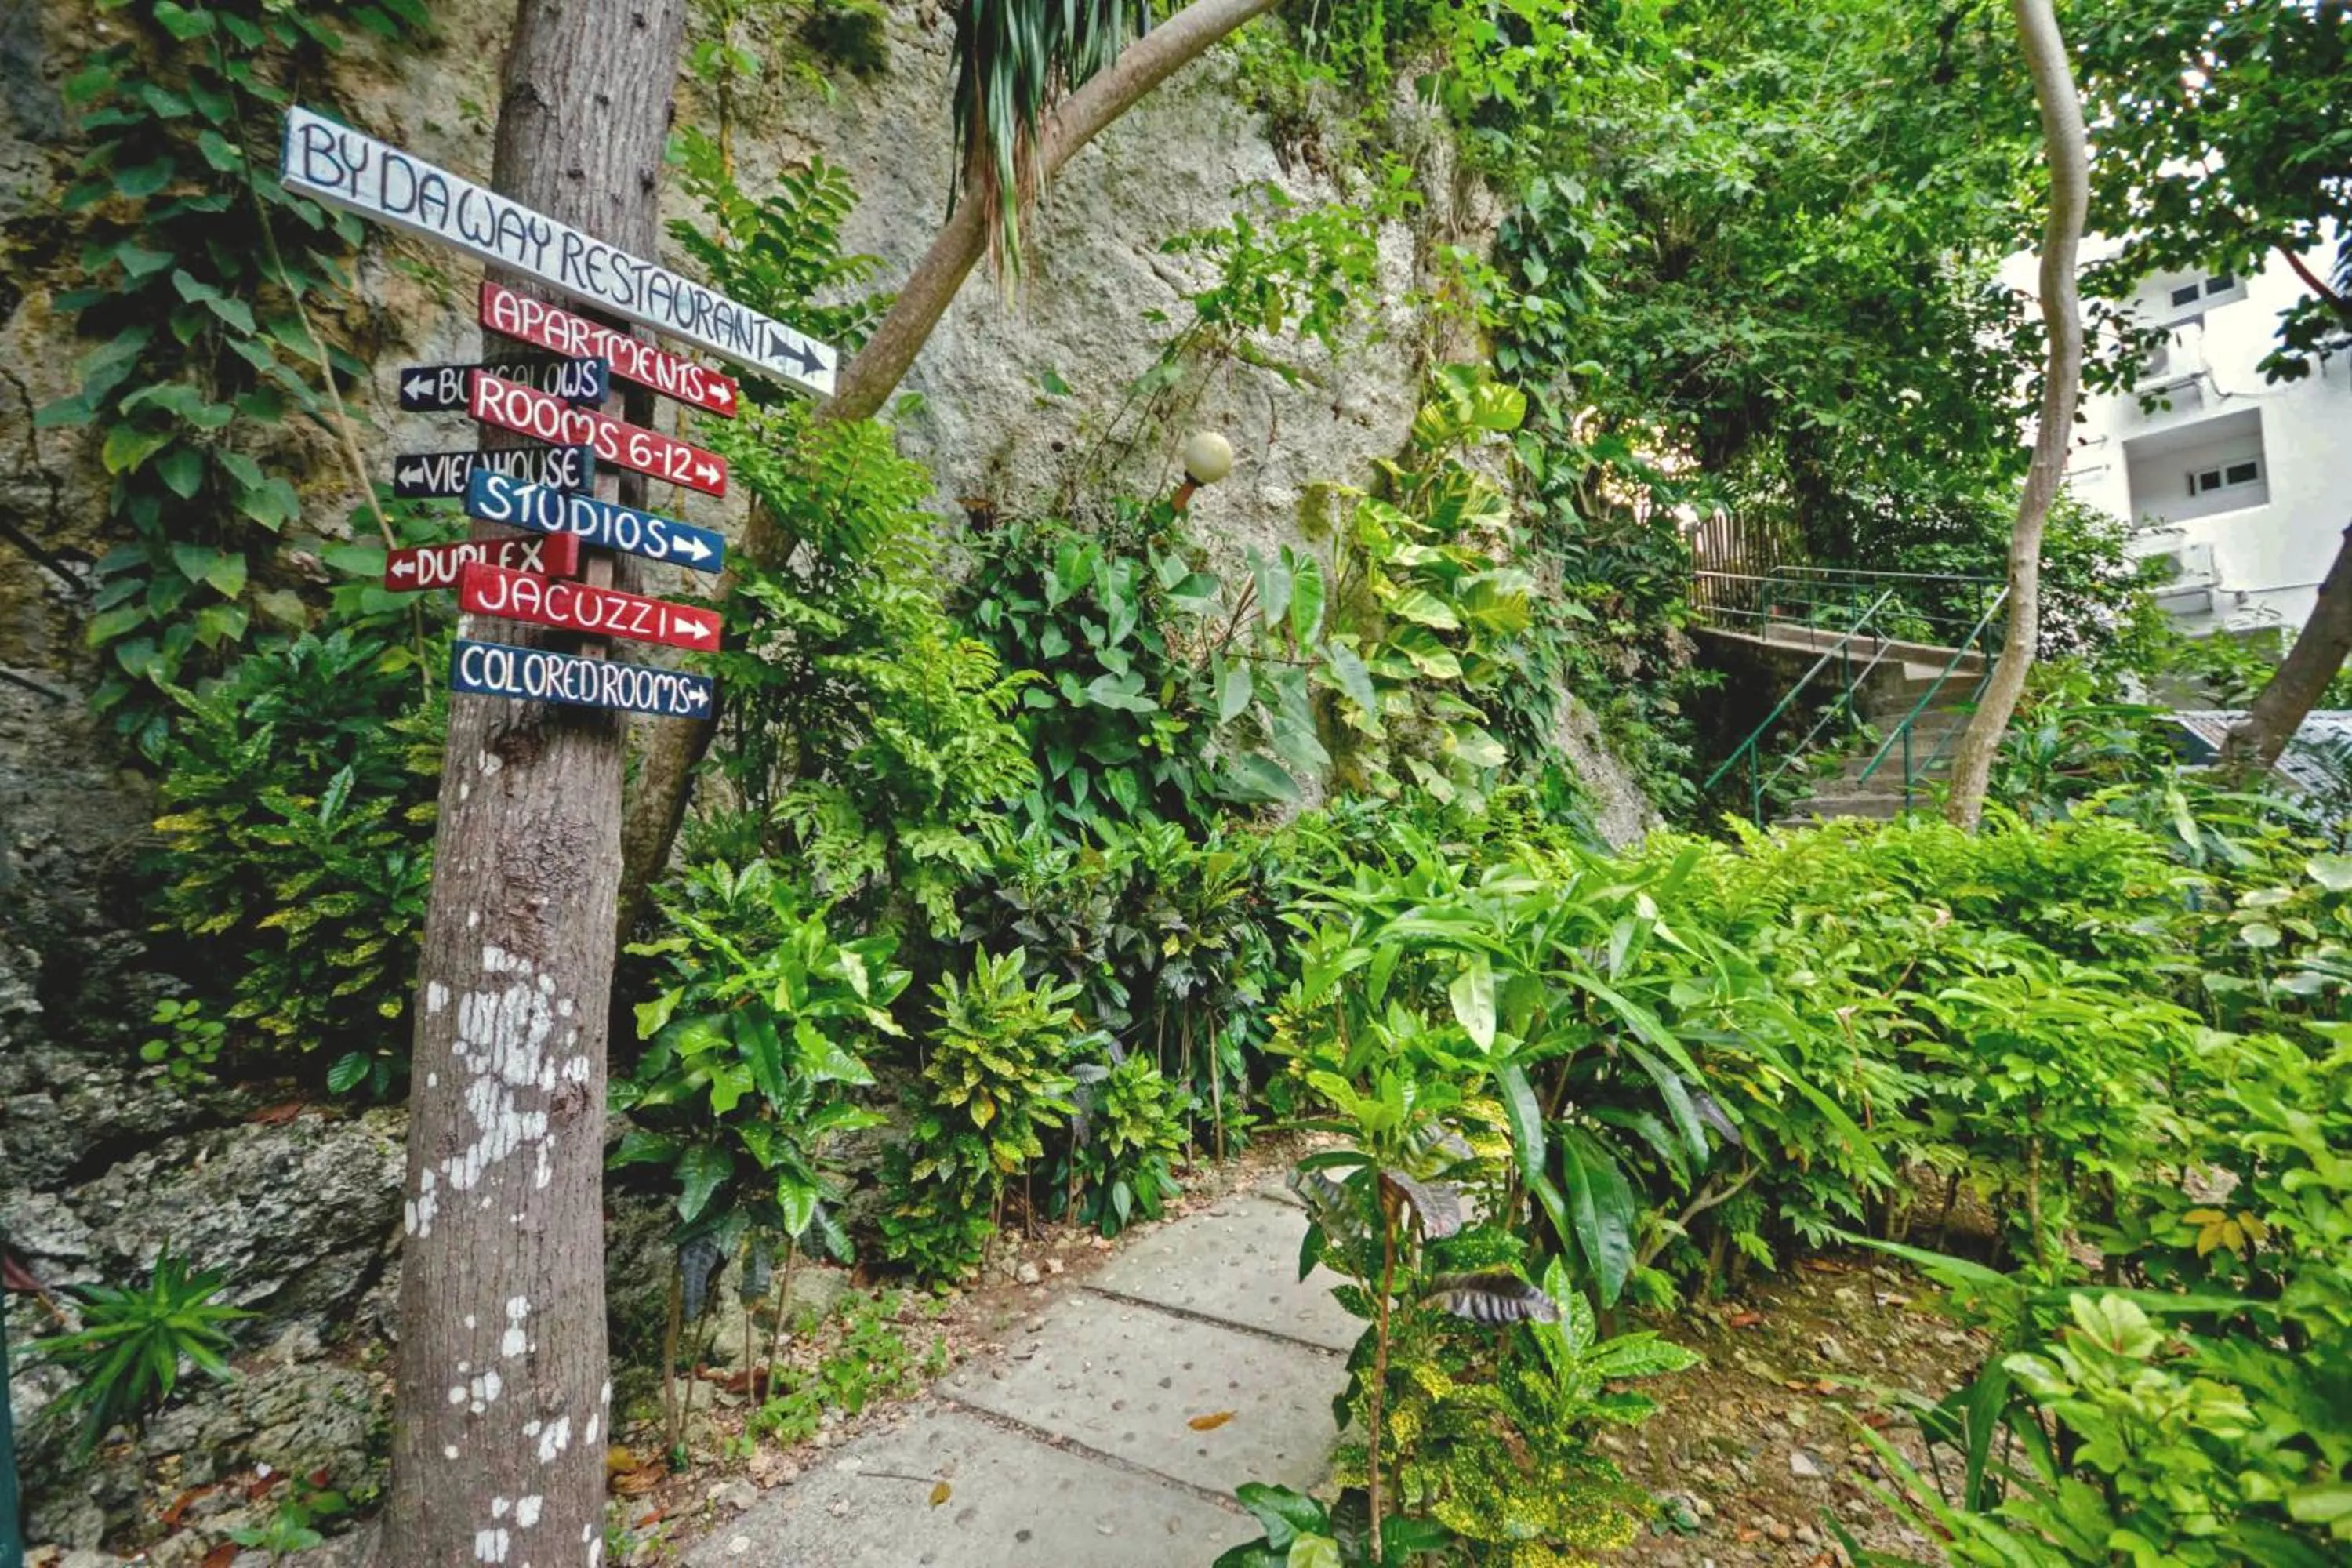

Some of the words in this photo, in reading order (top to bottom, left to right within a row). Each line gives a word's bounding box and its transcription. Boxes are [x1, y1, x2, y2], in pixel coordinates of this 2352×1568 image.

[298, 122, 368, 198] BY
[380, 151, 449, 229] DA
[458, 189, 551, 271] WAY
[562, 232, 771, 360] RESTAURANT
[494, 290, 706, 401] APARTMENTS
[477, 377, 619, 459] ROOMS
[630, 433, 693, 481] 6-12
[478, 475, 669, 559] STUDIOS
[477, 571, 666, 637] JACUZZI
[460, 645, 599, 702] COLORED
[602, 664, 692, 714] ROOMS
